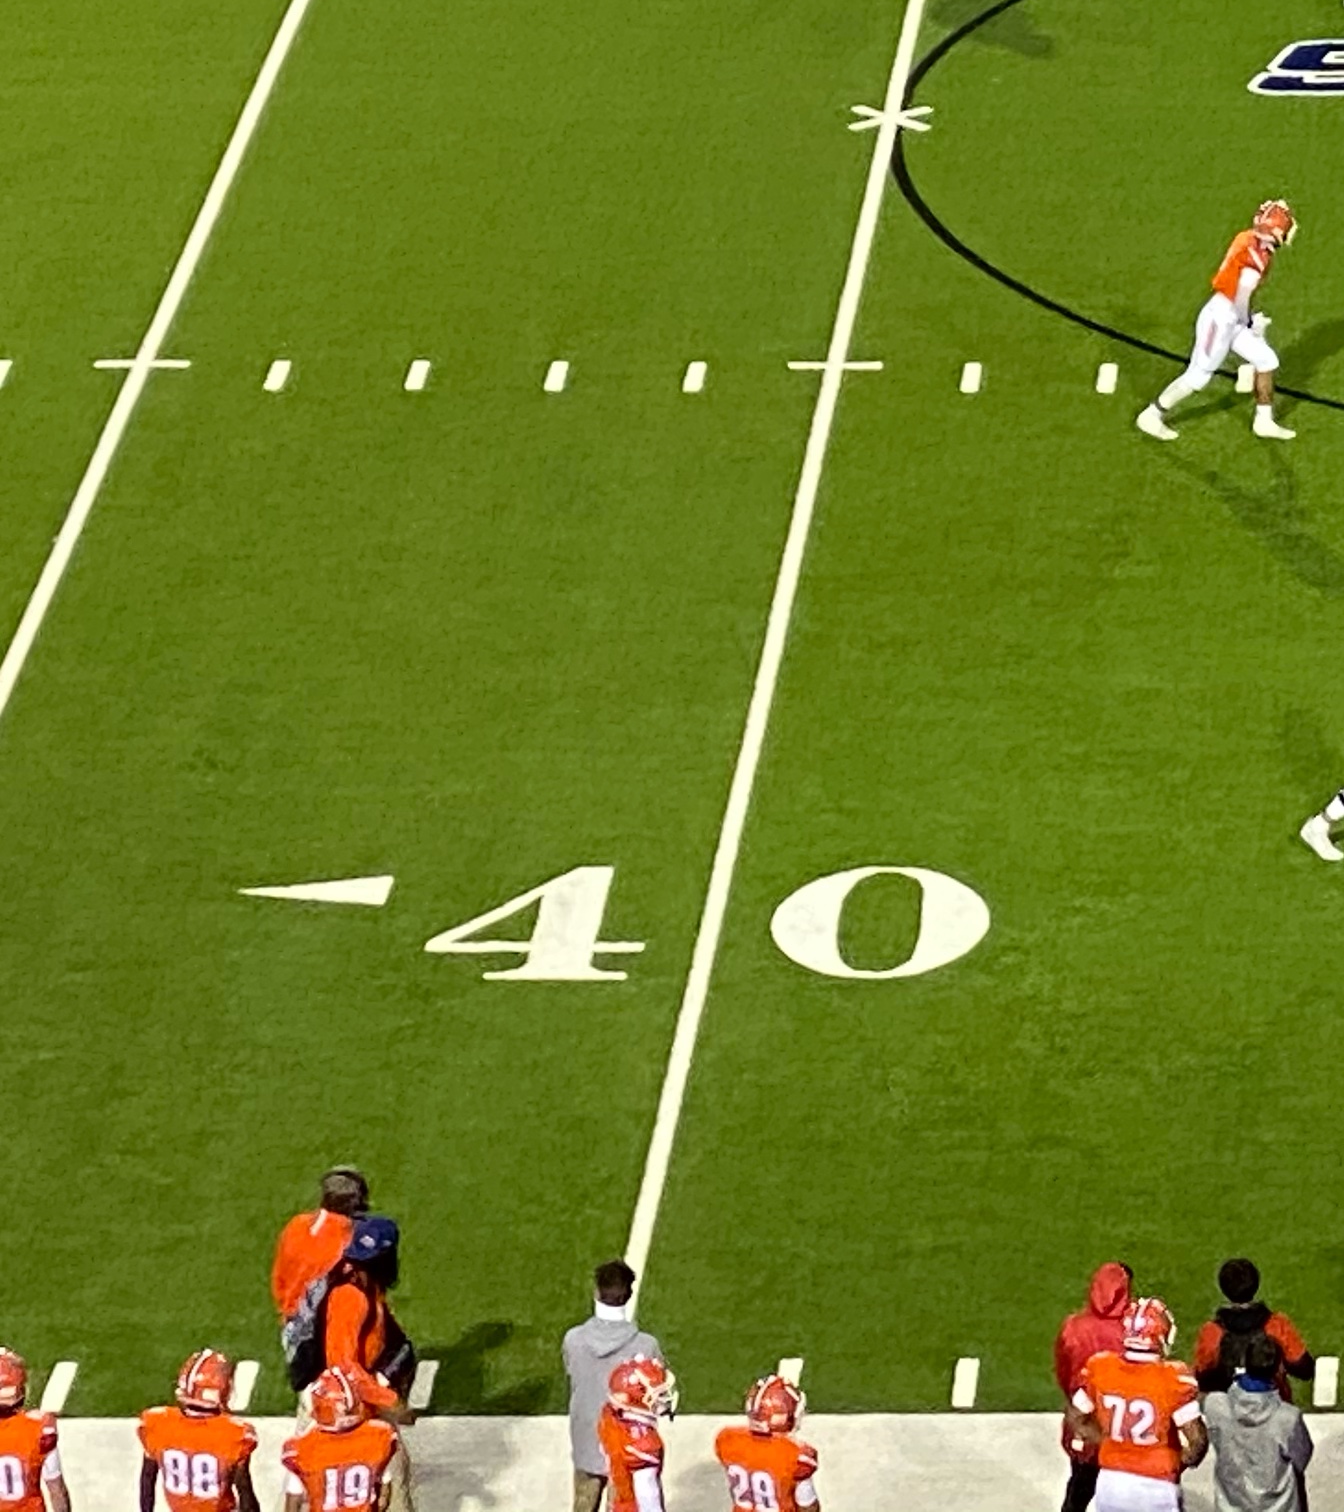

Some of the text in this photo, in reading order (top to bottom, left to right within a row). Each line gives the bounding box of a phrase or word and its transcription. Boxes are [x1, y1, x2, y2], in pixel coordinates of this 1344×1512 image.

[424, 866, 991, 980] 40
[1102, 1394, 1158, 1446] 72
[322, 1464, 374, 1510] 19
